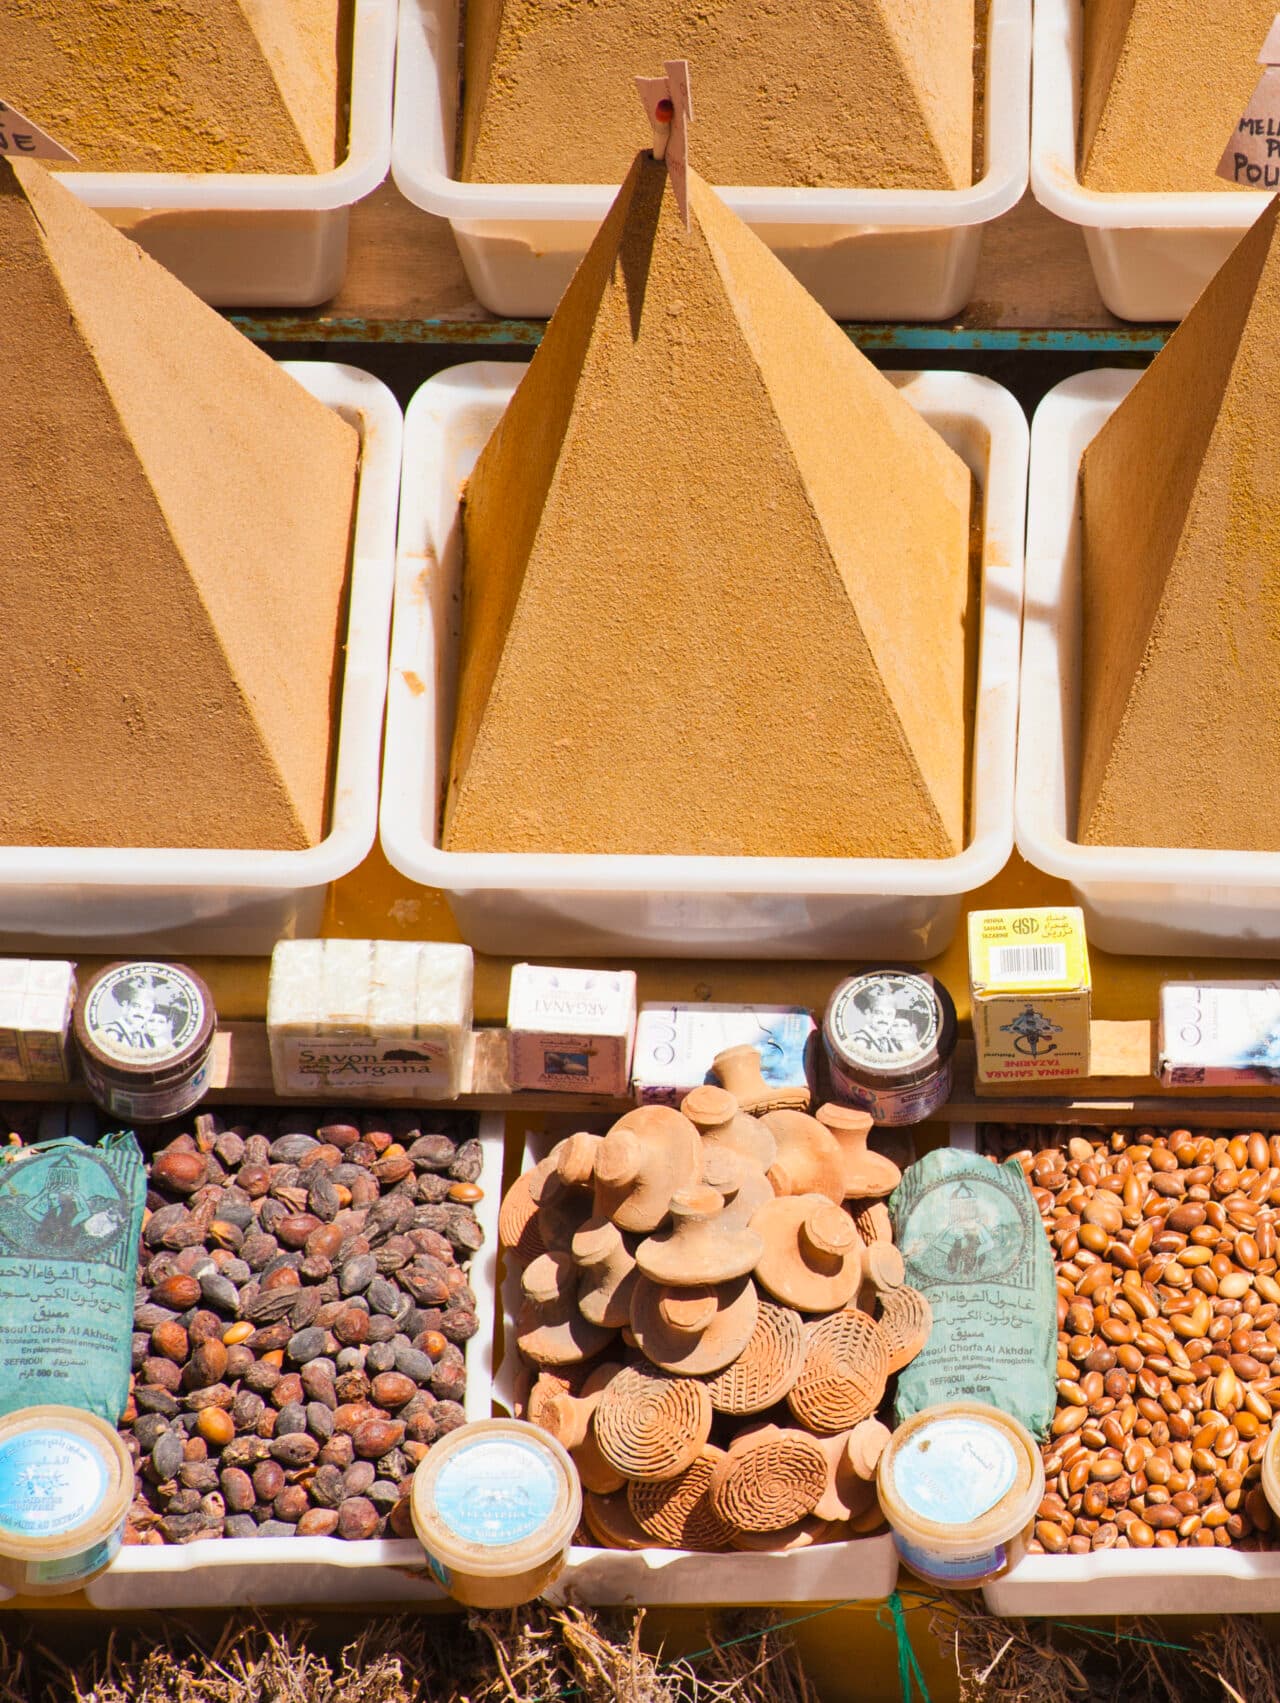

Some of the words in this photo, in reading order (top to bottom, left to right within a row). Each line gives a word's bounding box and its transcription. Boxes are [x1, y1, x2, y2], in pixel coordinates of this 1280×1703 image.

[300, 1050, 377, 1063] Savon
[1003, 1059, 1060, 1067] TAZARINE
[332, 1061, 432, 1077] Argana
[985, 1070, 1033, 1079] SAHARA
[1037, 1068, 1079, 1077] HENNA
[538, 1073, 596, 1083] ARGANAT
[0, 1325, 27, 1334] ssoul
[83, 1327, 118, 1343] Akhdar
[949, 1343, 983, 1353] Chorfa
[999, 1345, 1034, 1356] Akhdar
